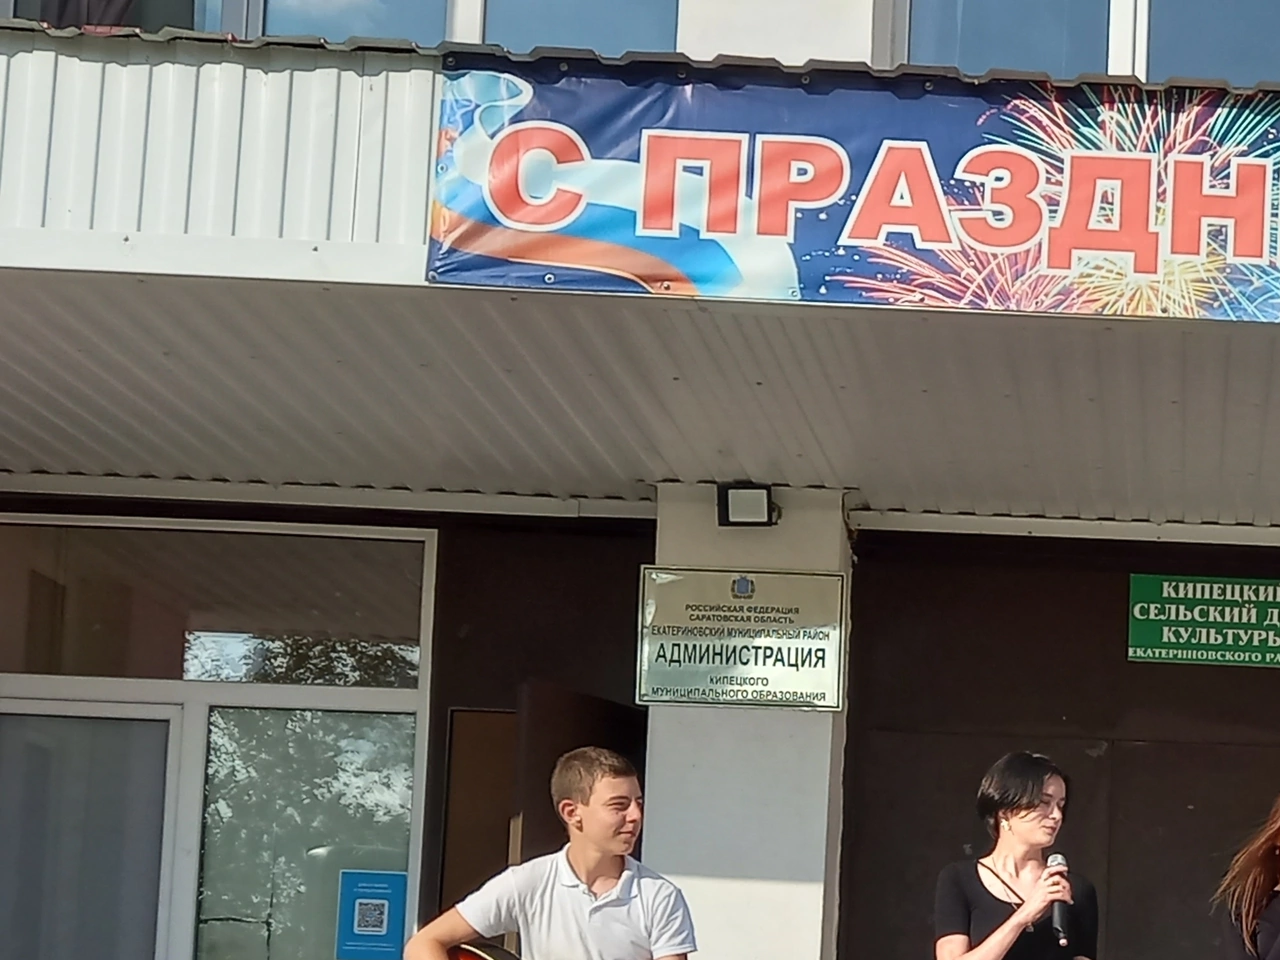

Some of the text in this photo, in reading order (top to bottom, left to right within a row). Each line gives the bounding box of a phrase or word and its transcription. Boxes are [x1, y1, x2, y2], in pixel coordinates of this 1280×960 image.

[485, 121, 592, 233] С
[685, 604, 799, 615] РОССИЙСКАЯ ФЕДЕРАЦИЯ
[1133, 603, 1258, 624] СЕЛЬСКИЙ
[689, 614, 795, 624] САРАТОВСКАЯ ОБЛАСТЬ
[651, 625, 830, 640] ЕКАТЕРИНОВСКИЙ МУНИЦИПАЛЬНЫЙ РАЙОН
[655, 643, 826, 671] АДМИНИСТРАЦИЯ
[709, 675, 769, 687] КИПЕЦКОГО
[651, 687, 826, 701] МУНИЦИПАЛЬНОГО ОБРАЗОВАНИЯ
